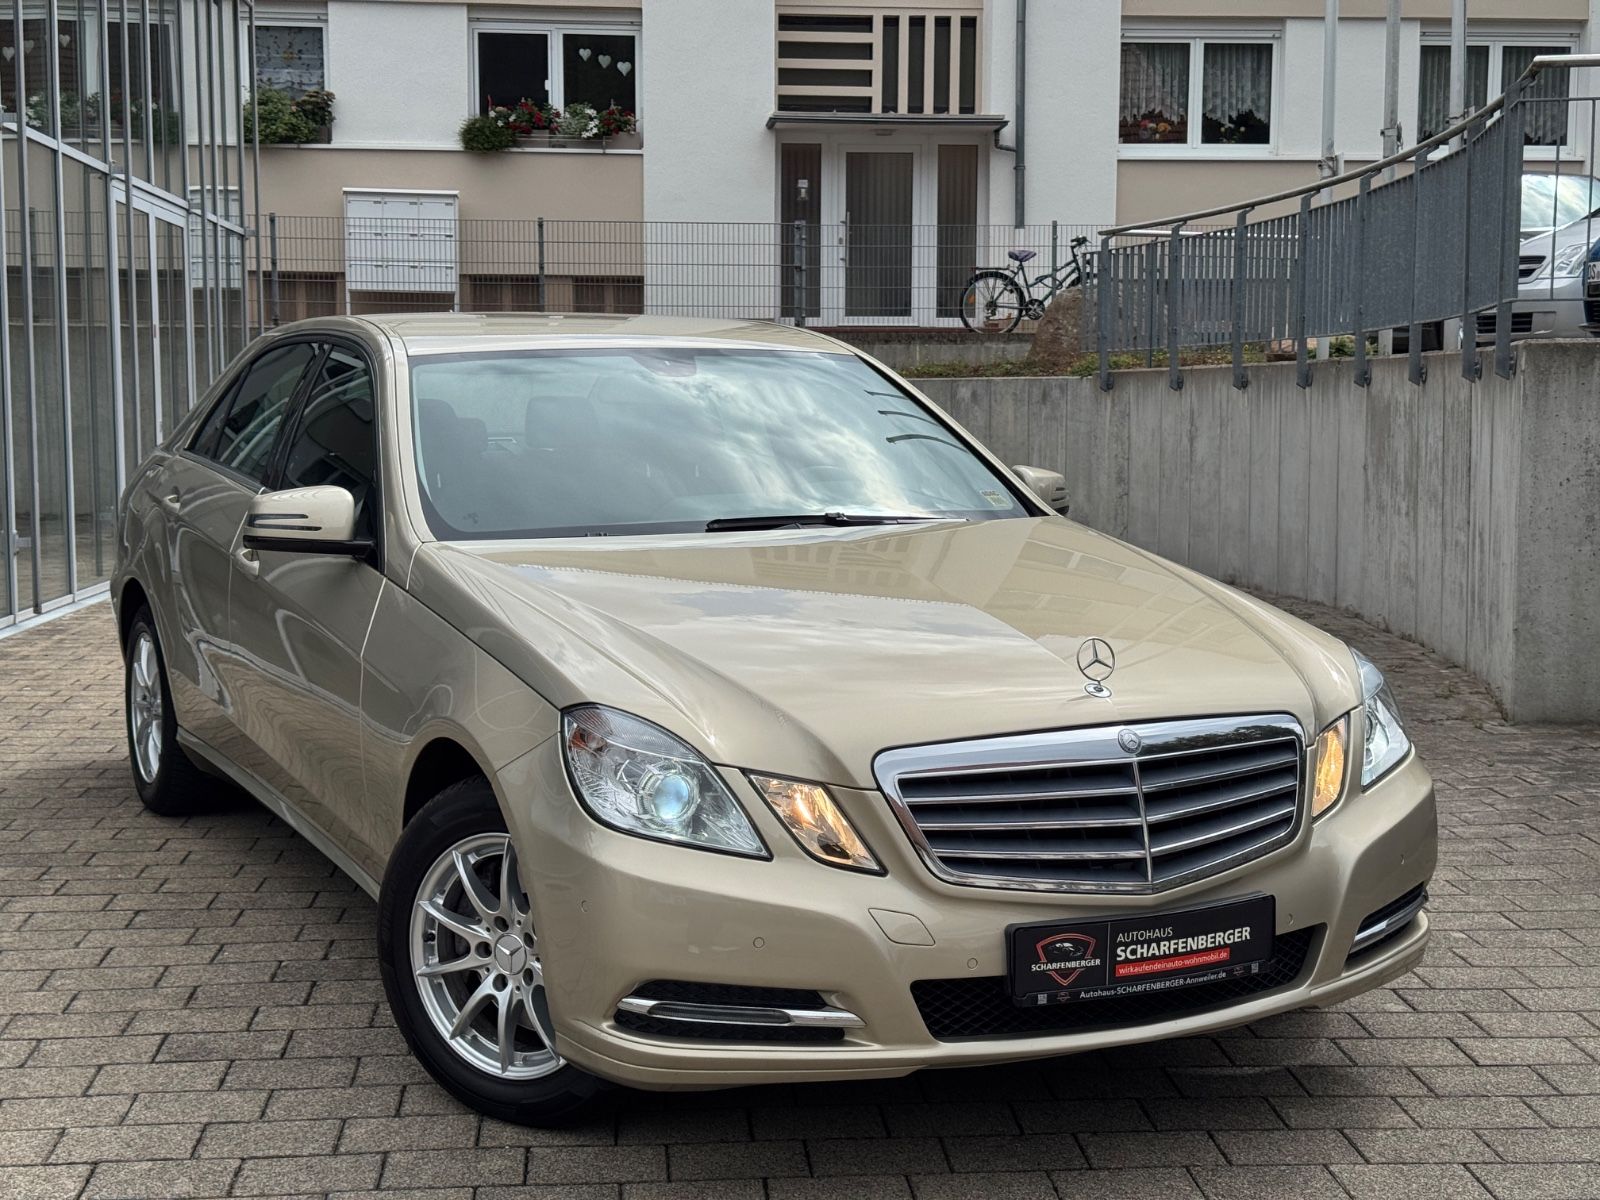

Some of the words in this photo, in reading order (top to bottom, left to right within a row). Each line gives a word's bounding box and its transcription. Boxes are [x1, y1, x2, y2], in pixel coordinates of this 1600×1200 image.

[1116, 927, 1173, 943] AUTOHAUS
[1116, 926, 1251, 961] SCHARFENBERGER
[1031, 958, 1101, 972] SCHARFENBERGER
[1118, 951, 1228, 975] wirkaufendeinauto-wohnmobil.de
[1079, 971, 1227, 999] Autohaus-SCHARFENBERGER-Annweiler.de
